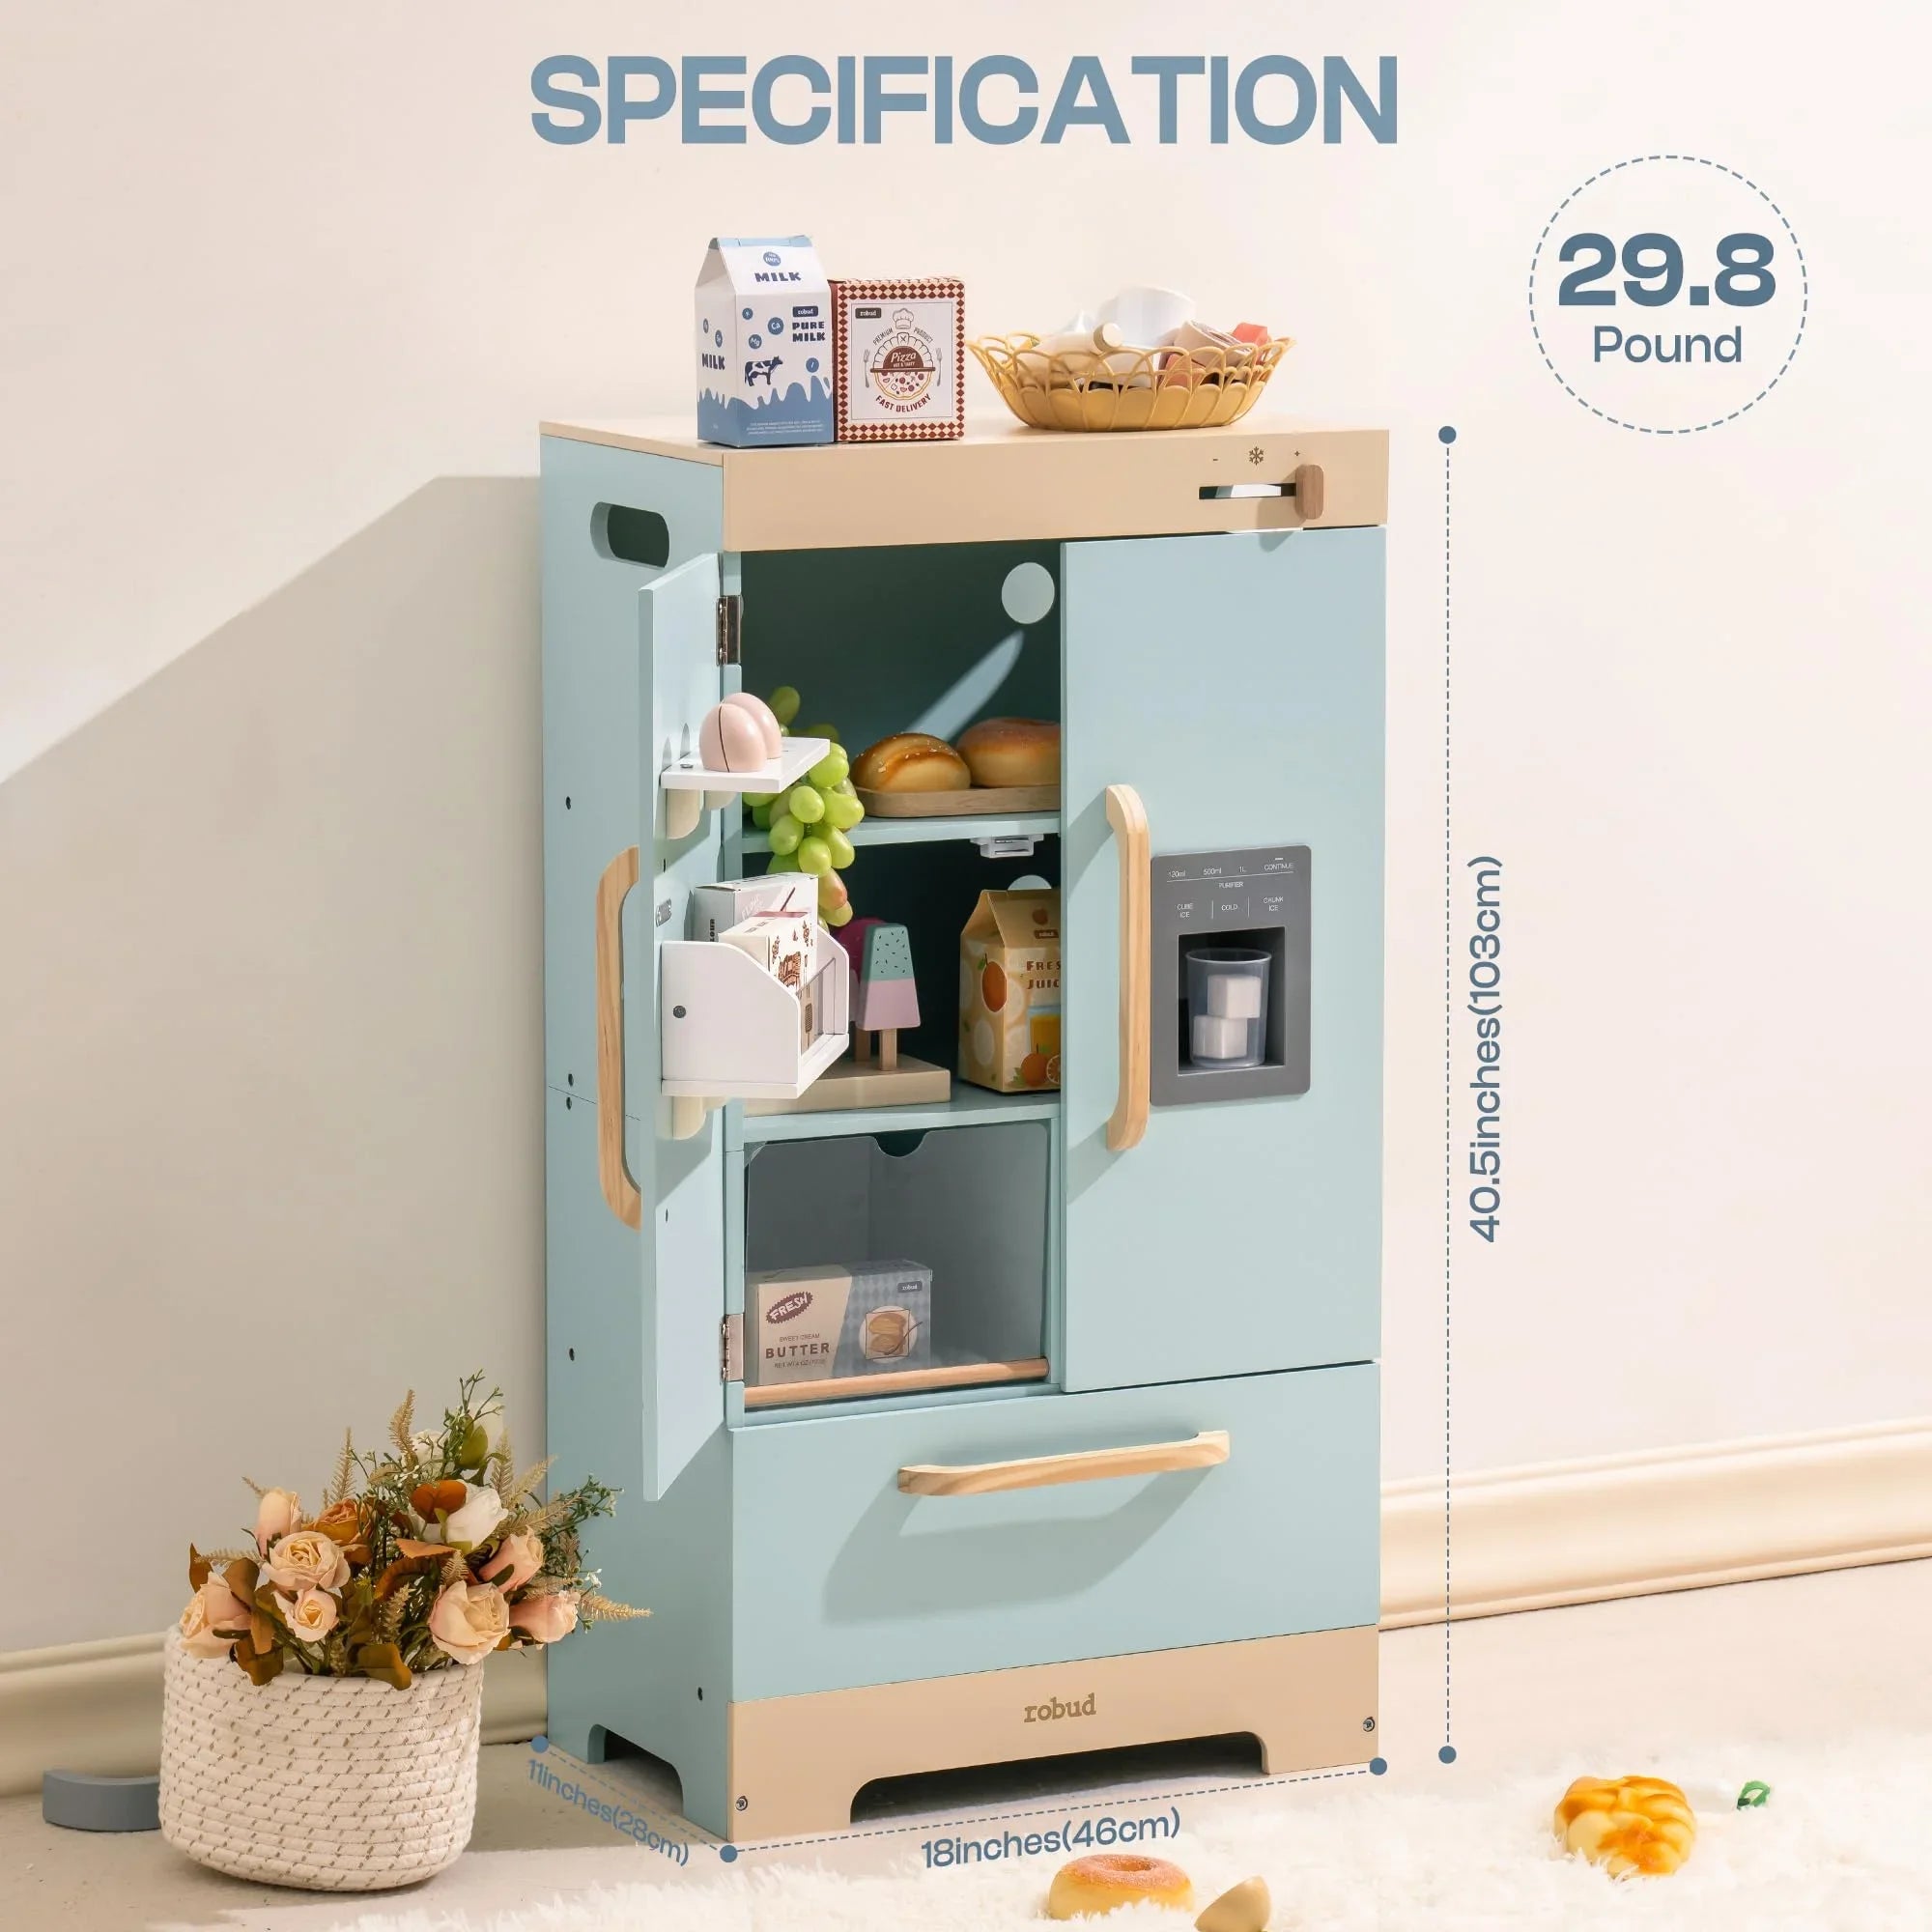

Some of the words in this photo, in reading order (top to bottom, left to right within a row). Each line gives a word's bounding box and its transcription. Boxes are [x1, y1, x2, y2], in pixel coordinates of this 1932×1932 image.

[754, 271, 802, 282] MILK
[792, 322, 825, 330] PURE
[792, 331, 826, 342] MILK
[701, 353, 725, 370] MILK
[891, 352, 917, 363] Pizza
[875, 394, 894, 411] FAST
[895, 393, 931, 412] DELIVERY
[1264, 863, 1294, 871] CONTINUE
[770, 1292, 809, 1321] FRESH
[765, 1342, 830, 1359] BUTTER
[1023, 1693, 1097, 1723] robud
